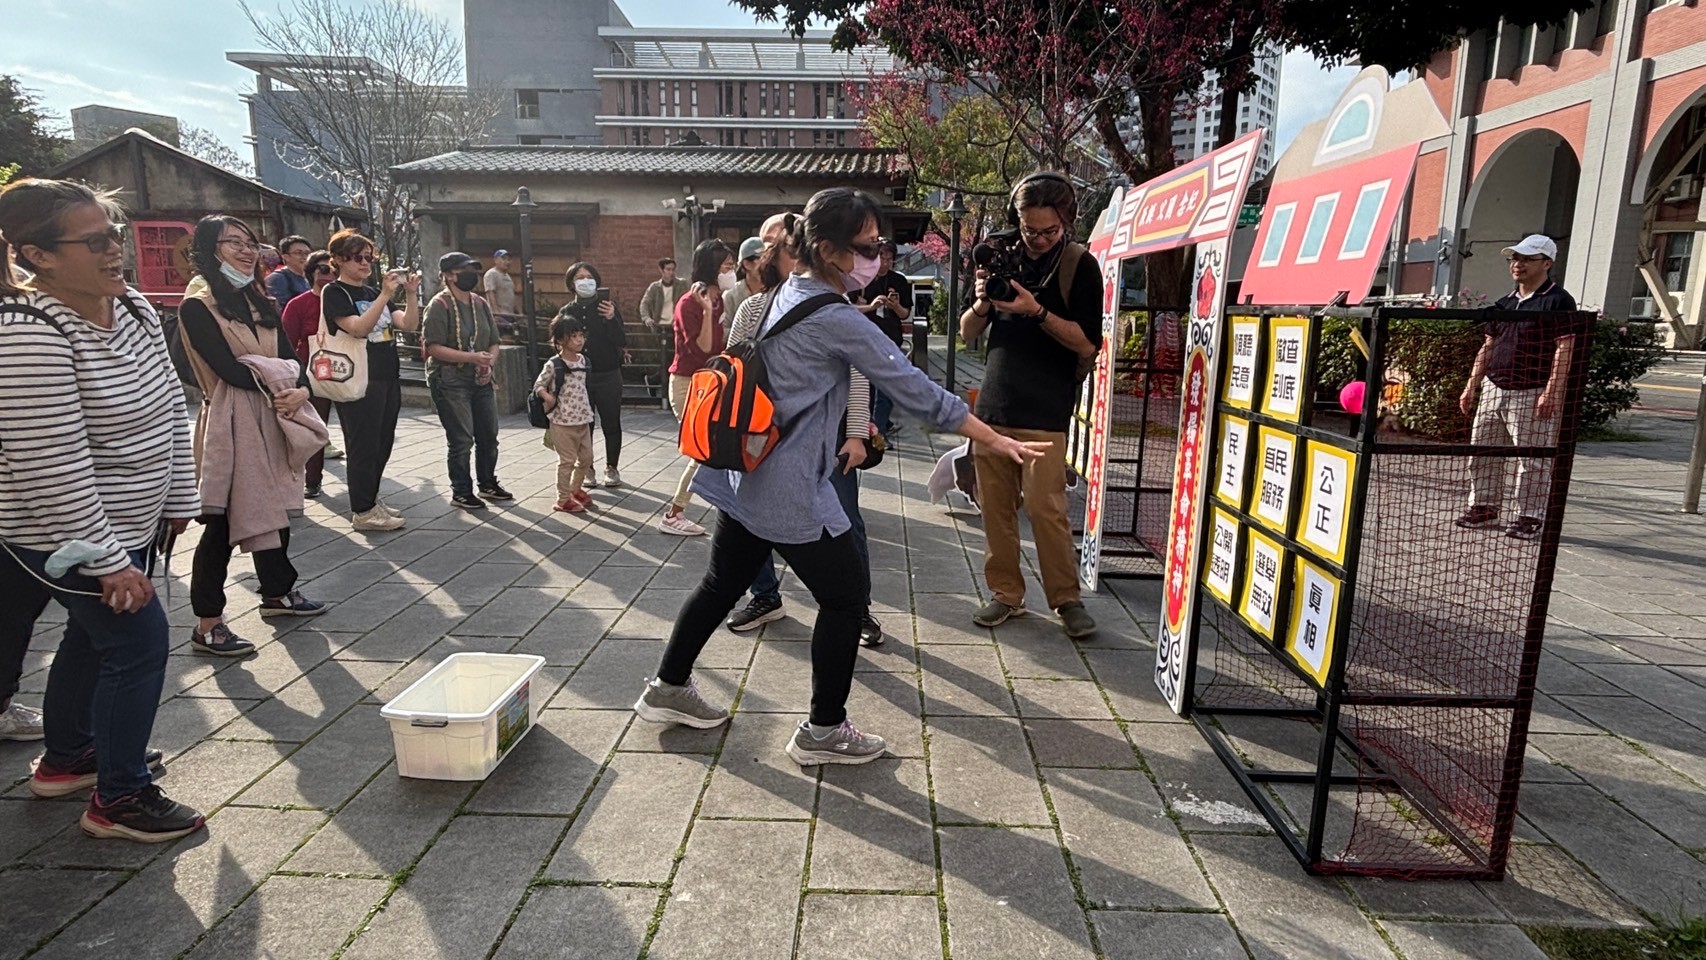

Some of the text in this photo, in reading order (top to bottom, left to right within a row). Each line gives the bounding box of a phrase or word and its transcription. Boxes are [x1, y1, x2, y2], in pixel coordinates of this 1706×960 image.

[1231, 365, 1250, 389] 民意
[1271, 373, 1296, 400] 到底
[1225, 432, 1239, 487] 民主
[1260, 479, 1285, 511] 服務
[1315, 465, 1335, 535] 公正
[1215, 524, 1233, 554] 公開
[1211, 554, 1230, 583] 透明
[1255, 550, 1277, 583] 選舉
[1251, 583, 1273, 618] 無效
